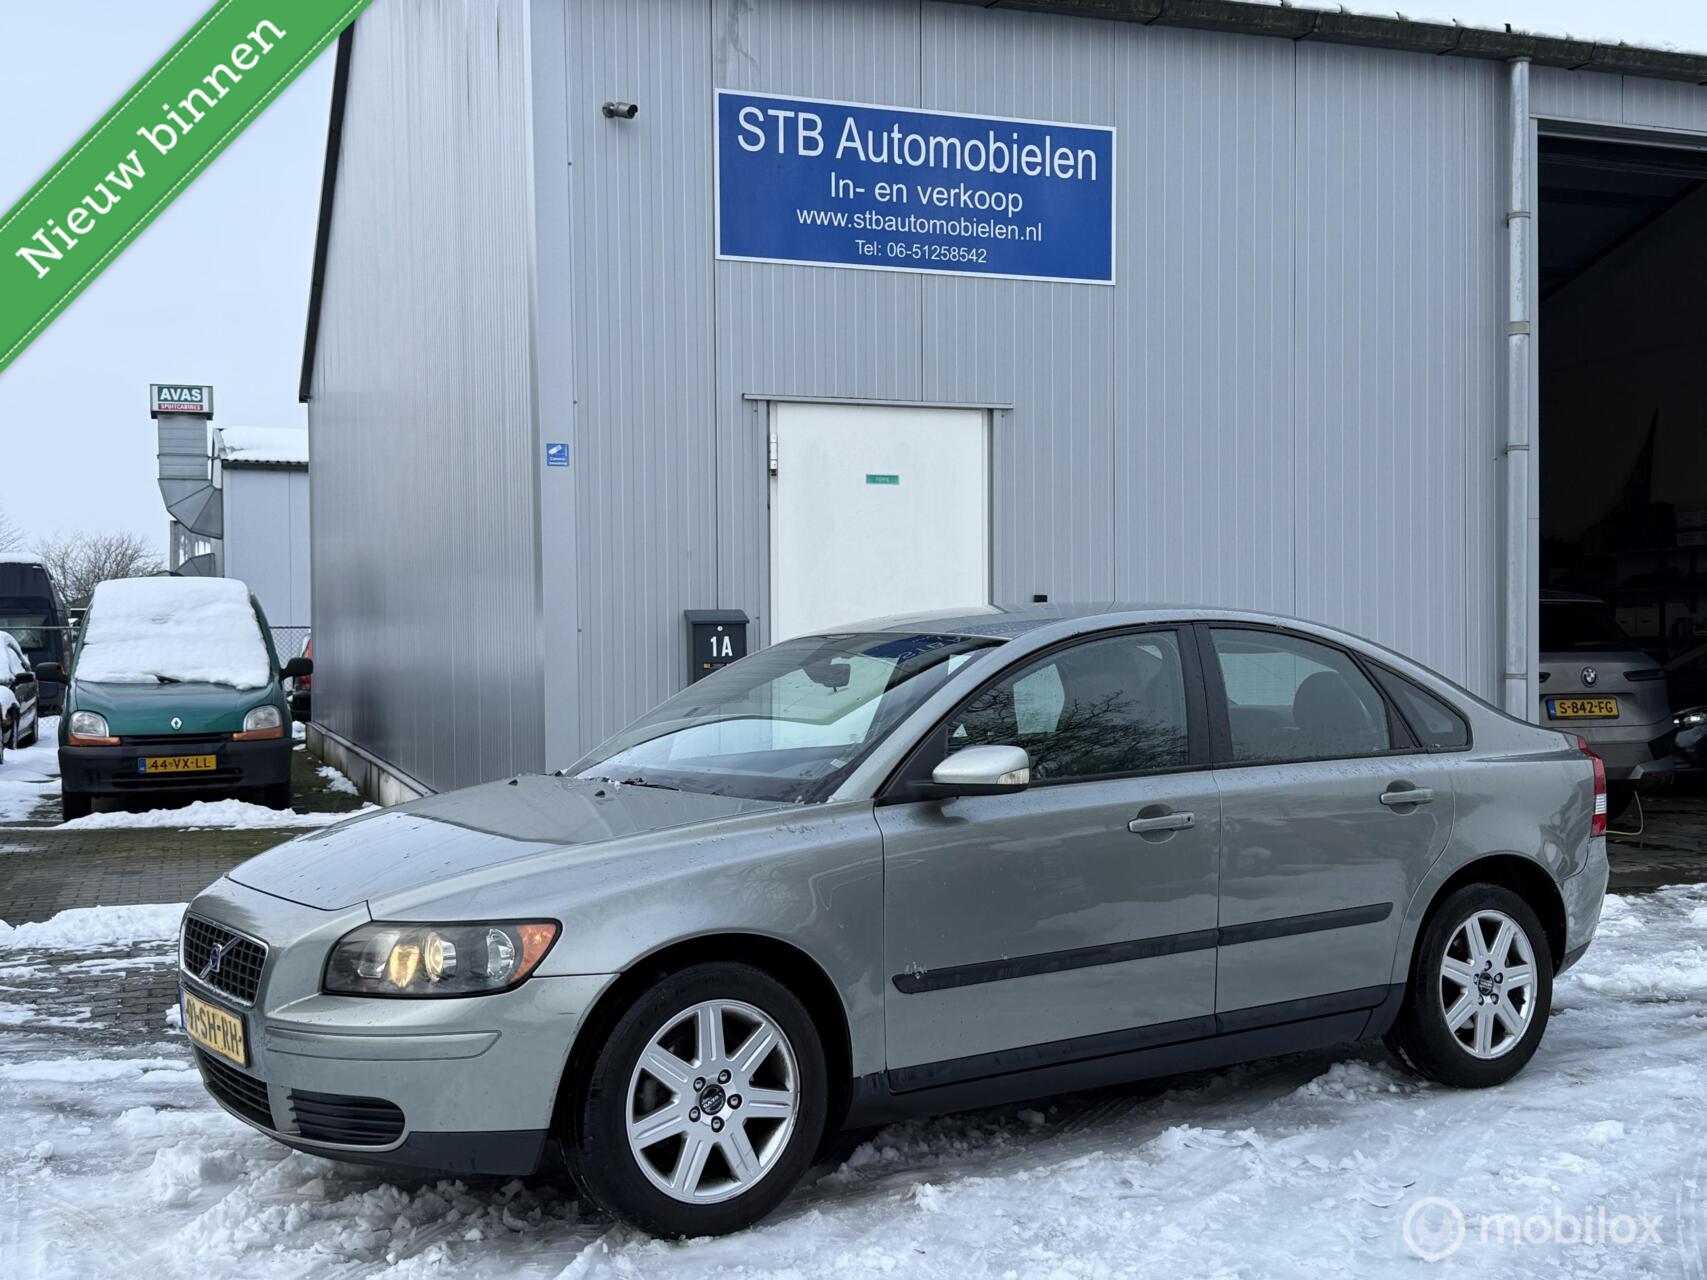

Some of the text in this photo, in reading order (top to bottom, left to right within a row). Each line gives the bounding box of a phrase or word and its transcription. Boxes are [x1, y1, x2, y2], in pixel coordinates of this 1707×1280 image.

[737, 106, 1098, 181] STB Automobielen
[830, 171, 1024, 218] In- en verkoop
[796, 208, 1042, 242] www.stbautomobielen.nl
[855, 239, 988, 263] Tel: 06-51258542
[160, 388, 202, 402] AVAS
[710, 635, 733, 657] 1A
[1559, 701, 1613, 714] S-842-FG
[151, 757, 211, 770] 44-VX-LL
